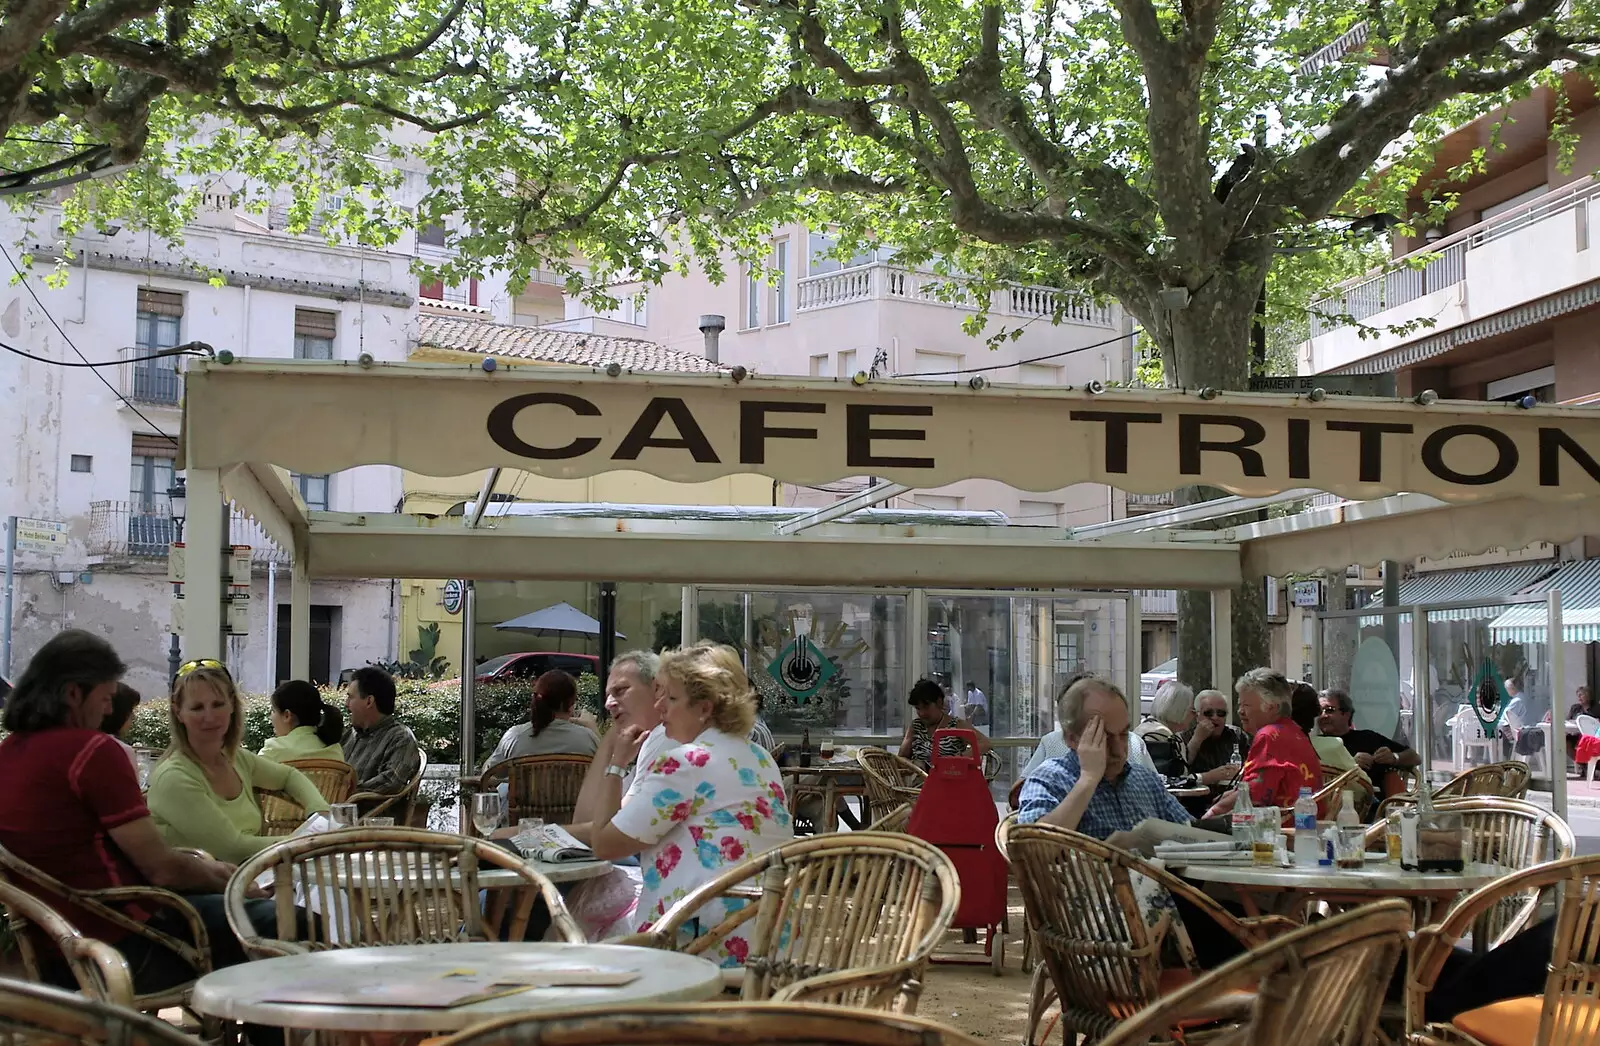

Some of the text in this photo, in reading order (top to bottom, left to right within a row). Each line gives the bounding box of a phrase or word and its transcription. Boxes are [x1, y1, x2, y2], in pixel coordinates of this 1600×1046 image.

[1300, 379, 1313, 389] DE
[487, 392, 1600, 486] CAFE TRITON
